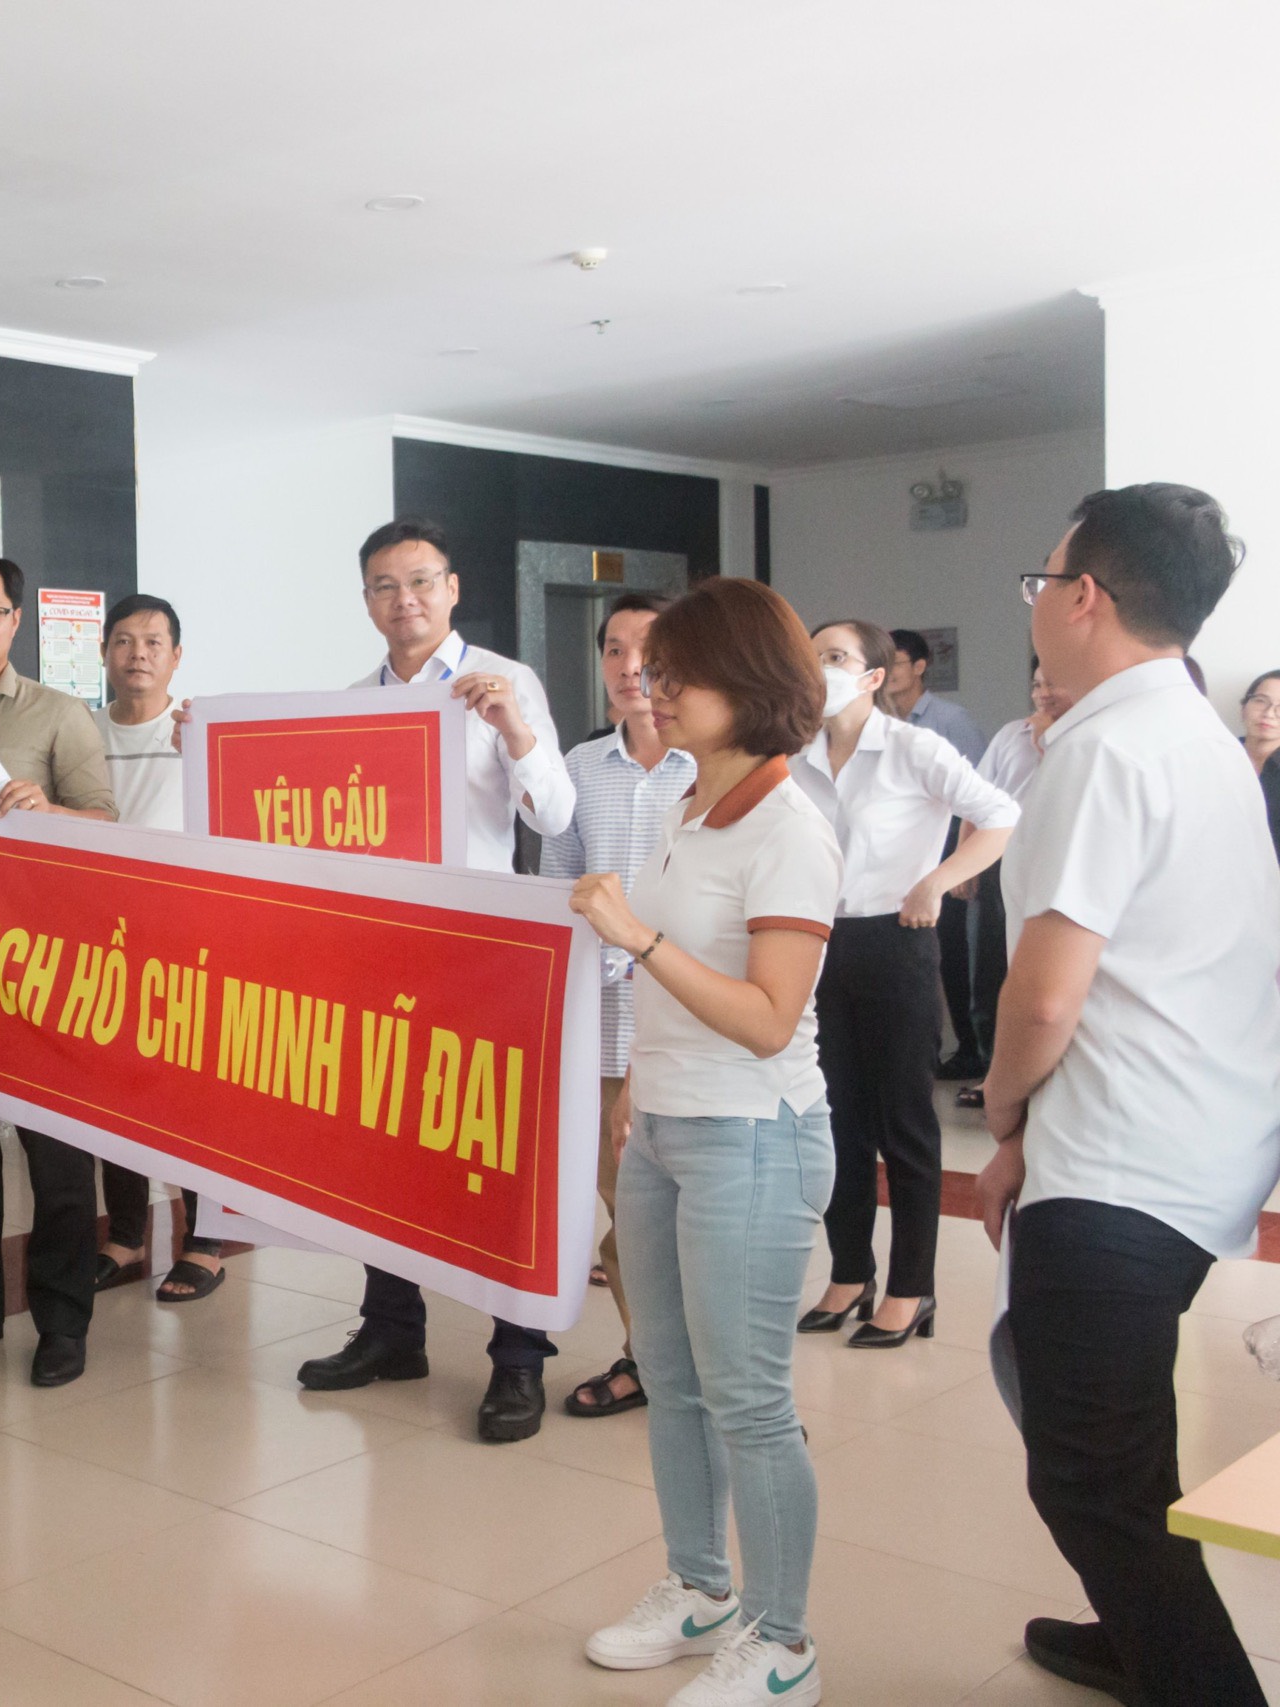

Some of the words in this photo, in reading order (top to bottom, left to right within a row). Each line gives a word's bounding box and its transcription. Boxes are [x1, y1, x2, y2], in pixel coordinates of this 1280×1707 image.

[253, 775, 312, 847] YÊU
[322, 764, 387, 847] CẦU
[58, 917, 127, 1046] HỒ
[137, 948, 209, 1073] CHÍ
[217, 976, 346, 1117] MINH
[360, 993, 417, 1138] VĨ
[419, 1027, 524, 1194] ĐẠI
